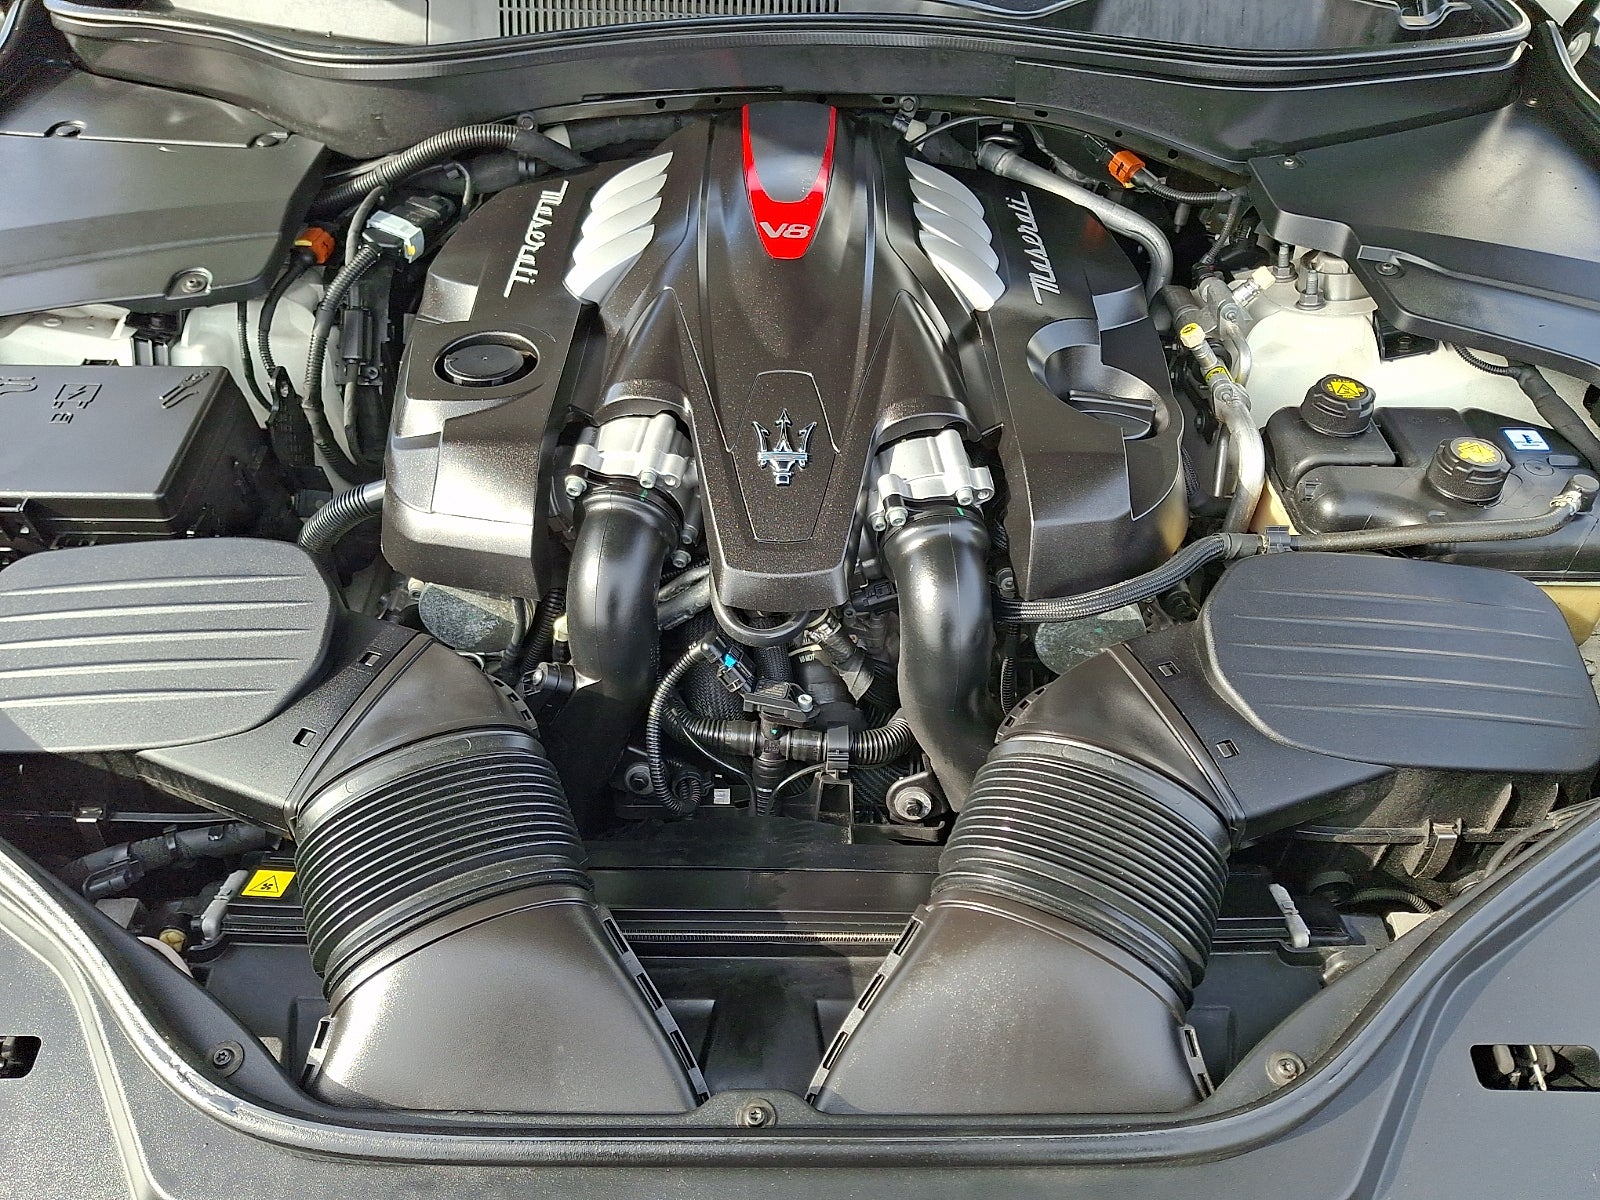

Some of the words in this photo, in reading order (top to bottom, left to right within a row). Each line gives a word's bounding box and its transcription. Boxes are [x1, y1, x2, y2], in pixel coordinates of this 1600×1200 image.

[503, 180, 569, 298] Maserati
[759, 221, 811, 239] V8
[1005, 190, 1060, 305] Maserati
